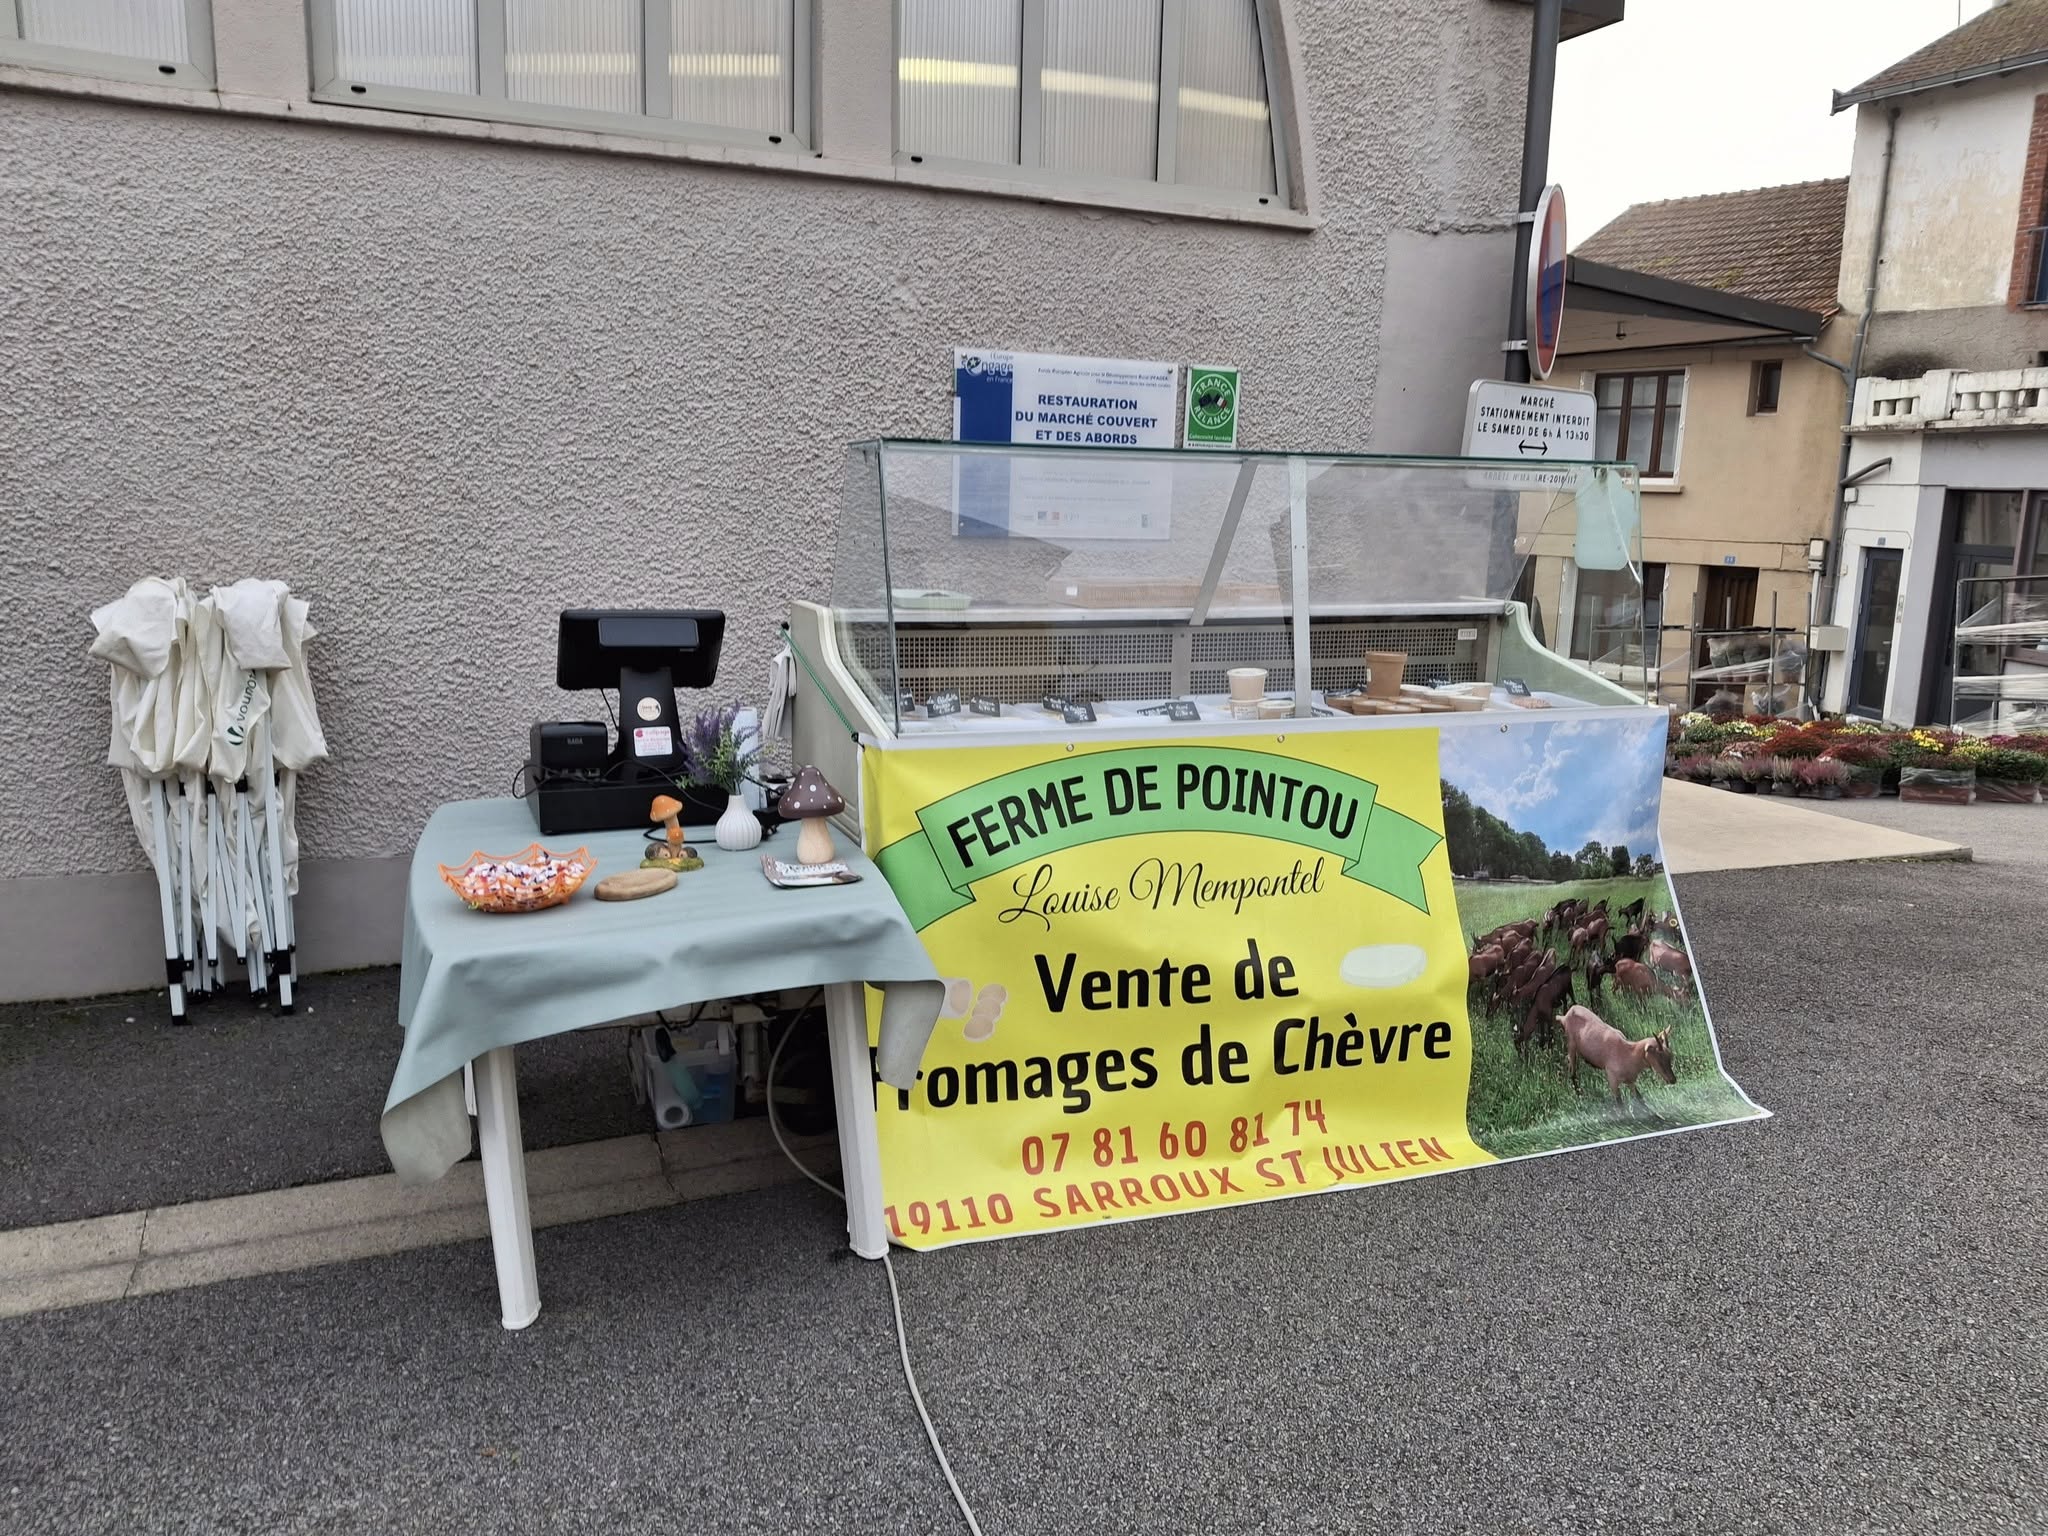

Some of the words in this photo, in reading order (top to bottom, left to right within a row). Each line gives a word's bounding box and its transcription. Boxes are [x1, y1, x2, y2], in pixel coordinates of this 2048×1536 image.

[1196, 378, 1231, 395] FRANCE
[1038, 394, 1138, 410] RESTAURATION
[1520, 395, 1555, 409] MARCHÉ
[1015, 411, 1034, 422] DU
[1038, 412, 1094, 425] MARCHÉ
[1097, 415, 1158, 428] COUVERT
[1194, 405, 1231, 425] RELANCE
[1480, 406, 1550, 423] STATIONNEMENT
[1552, 413, 1590, 427] INTERDIT
[1035, 430, 1053, 441] ET
[1056, 431, 1081, 442] DES
[1085, 432, 1138, 445] ABORDS
[1477, 422, 1488, 433] LE
[1491, 423, 1525, 436] SAMEDI
[1528, 426, 1539, 437] DE
[1542, 428, 1553, 438] 6h
[1565, 429, 1590, 441] 13h30
[947, 775, 1093, 868] FERME
[1103, 765, 1162, 816] DE
[1177, 763, 1359, 840] POINTOU
[998, 863, 1121, 932] Louise
[1129, 856, 1326, 915] Mempontel
[1034, 952, 1211, 1013] Vente
[1234, 938, 1299, 1000] de
[1181, 1023, 1250, 1086] de
[1273, 1012, 1452, 1076] Chèvre
[1021, 1133, 1070, 1175] 07
[1092, 1126, 1139, 1167] 81
[1158, 1120, 1207, 1160] 60
[1229, 1112, 1270, 1154] 81
[1284, 1099, 1328, 1136] 74
[884, 1193, 1014, 1237] 19110
[1032, 1166, 1244, 1218] SARROUX
[1256, 1150, 1307, 1187] ST
[1322, 1137, 1454, 1181] JULIEN
